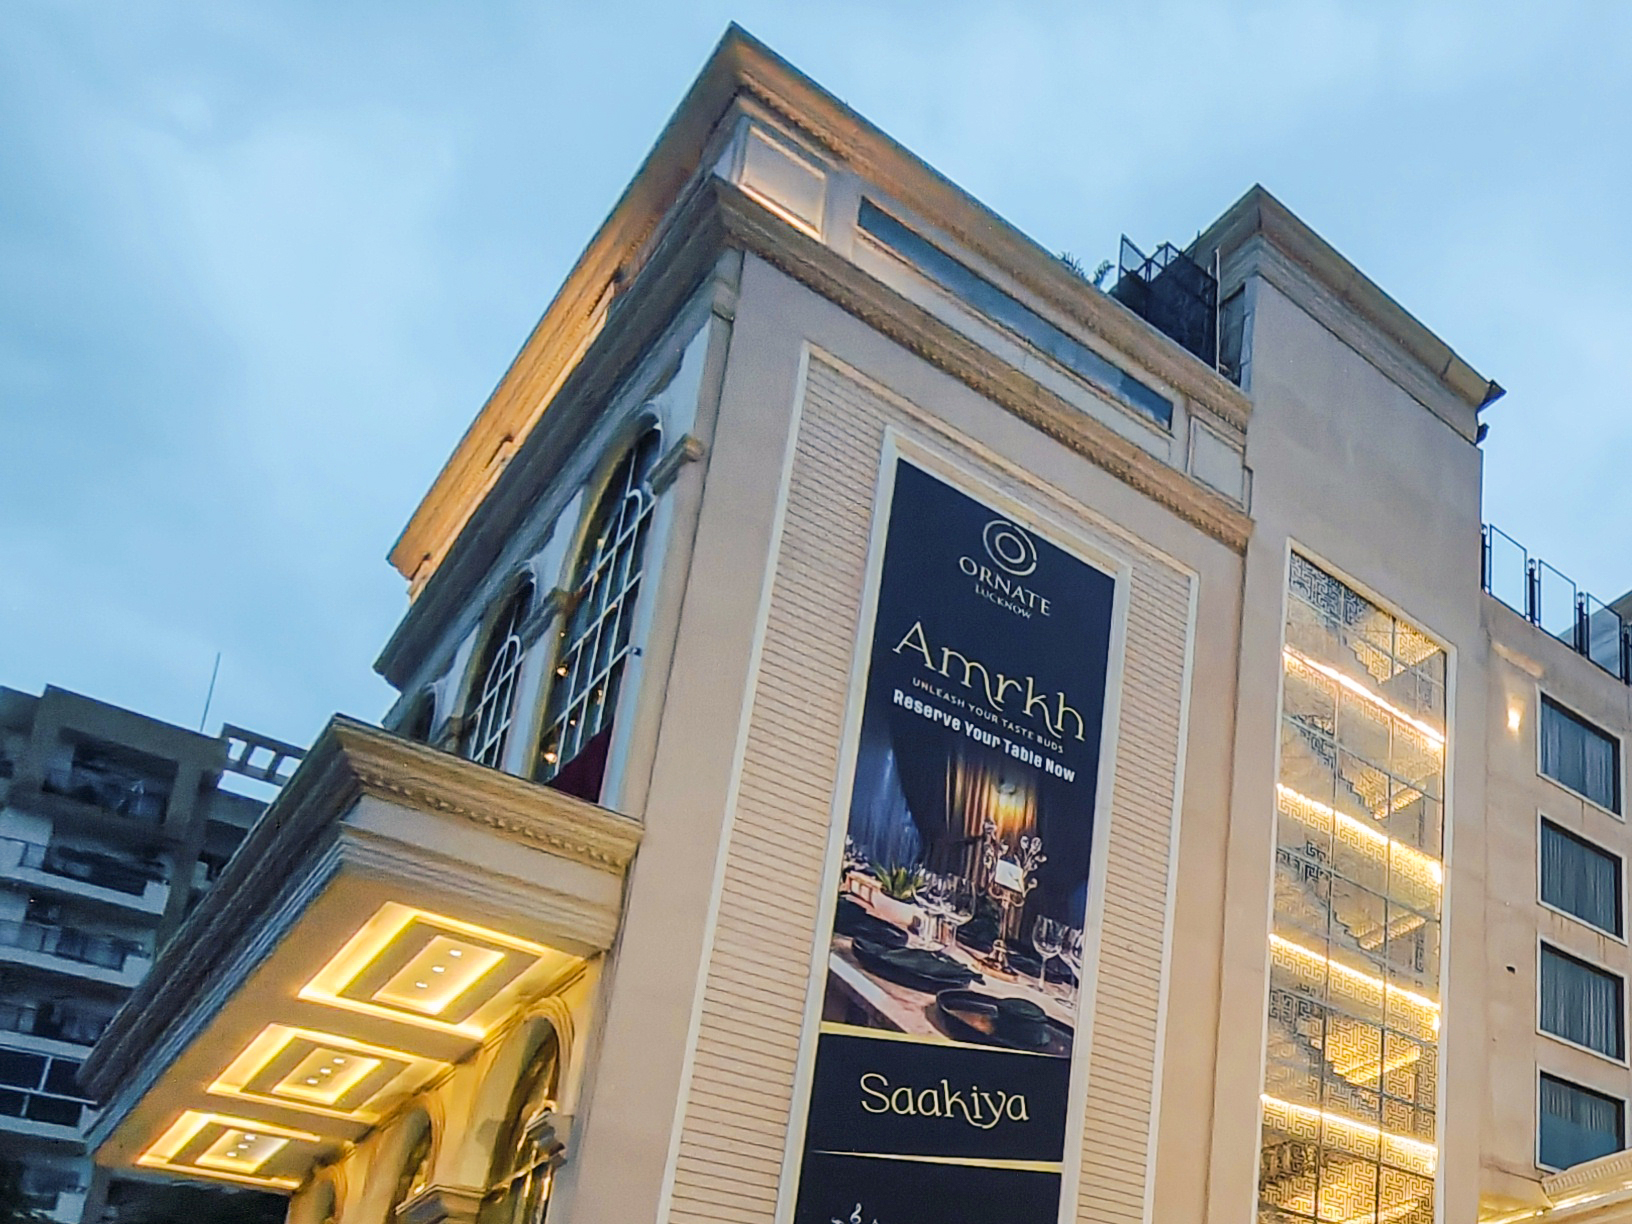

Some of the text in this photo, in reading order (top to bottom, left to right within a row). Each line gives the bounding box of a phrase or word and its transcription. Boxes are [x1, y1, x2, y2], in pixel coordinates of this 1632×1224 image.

[959, 556, 1052, 616] ORNATE
[975, 583, 1032, 620] LUCKNOW
[892, 621, 1086, 741] Amrkh
[893, 689, 1076, 783] Reserve Your Table Now
[912, 677, 1064, 754] UNLEASH YOUR TASTE BUDS
[860, 1073, 1029, 1129] Saakiya
